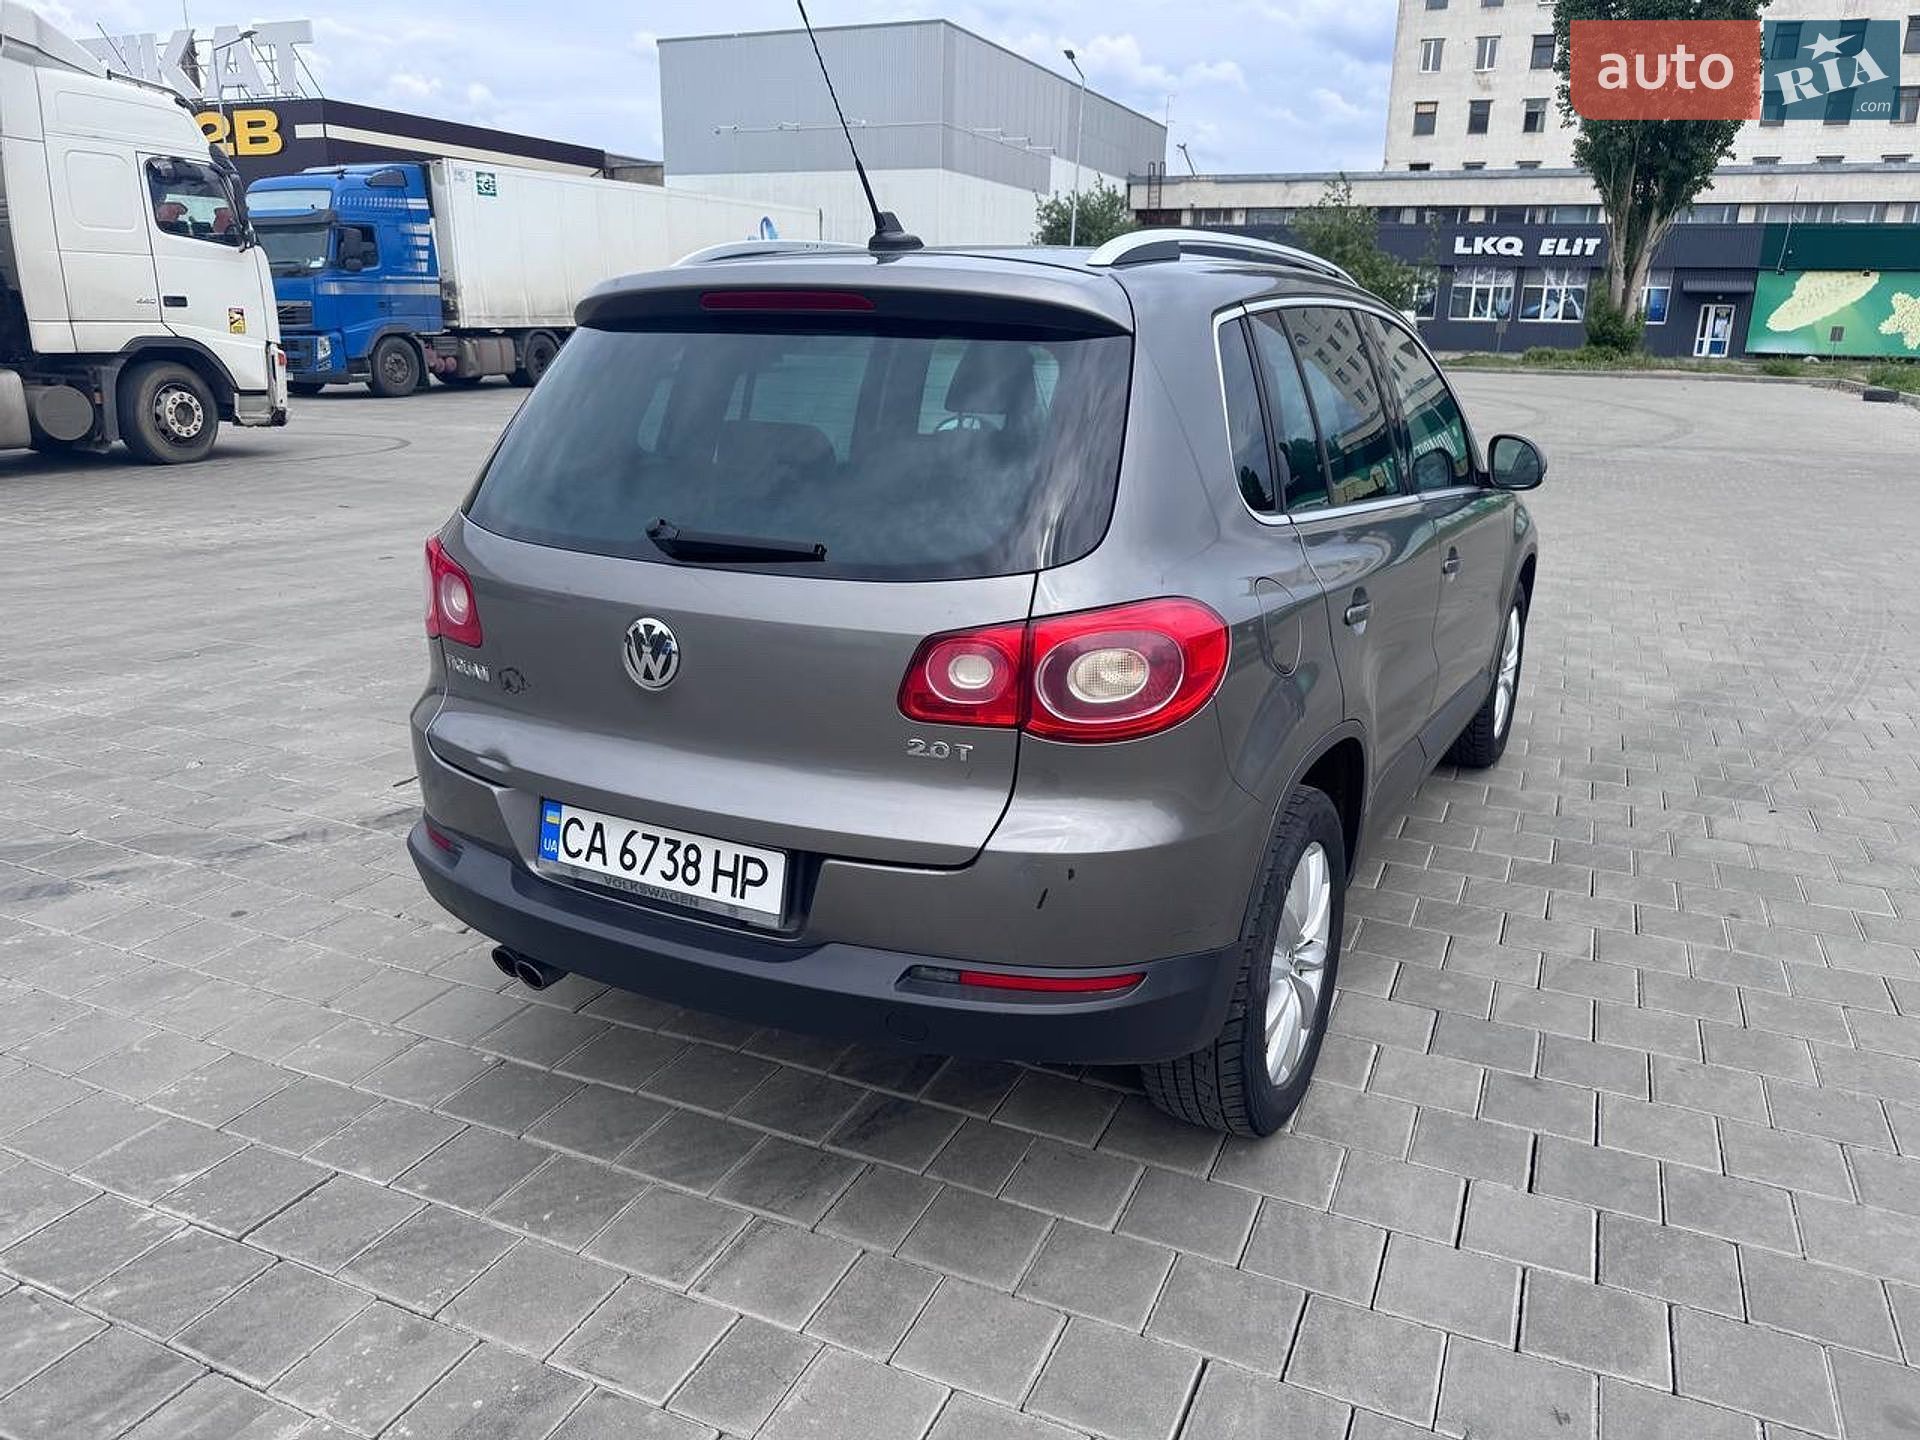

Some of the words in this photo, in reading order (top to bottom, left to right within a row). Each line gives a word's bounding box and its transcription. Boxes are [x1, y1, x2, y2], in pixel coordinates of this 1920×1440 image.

[1454, 236, 1524, 256] LKQ
[543, 838, 558, 853] UA
[561, 817, 609, 867] CA
[619, 830, 702, 886] 6738
[711, 849, 769, 900] HP
[603, 875, 700, 907] VOLKSWAGEN
